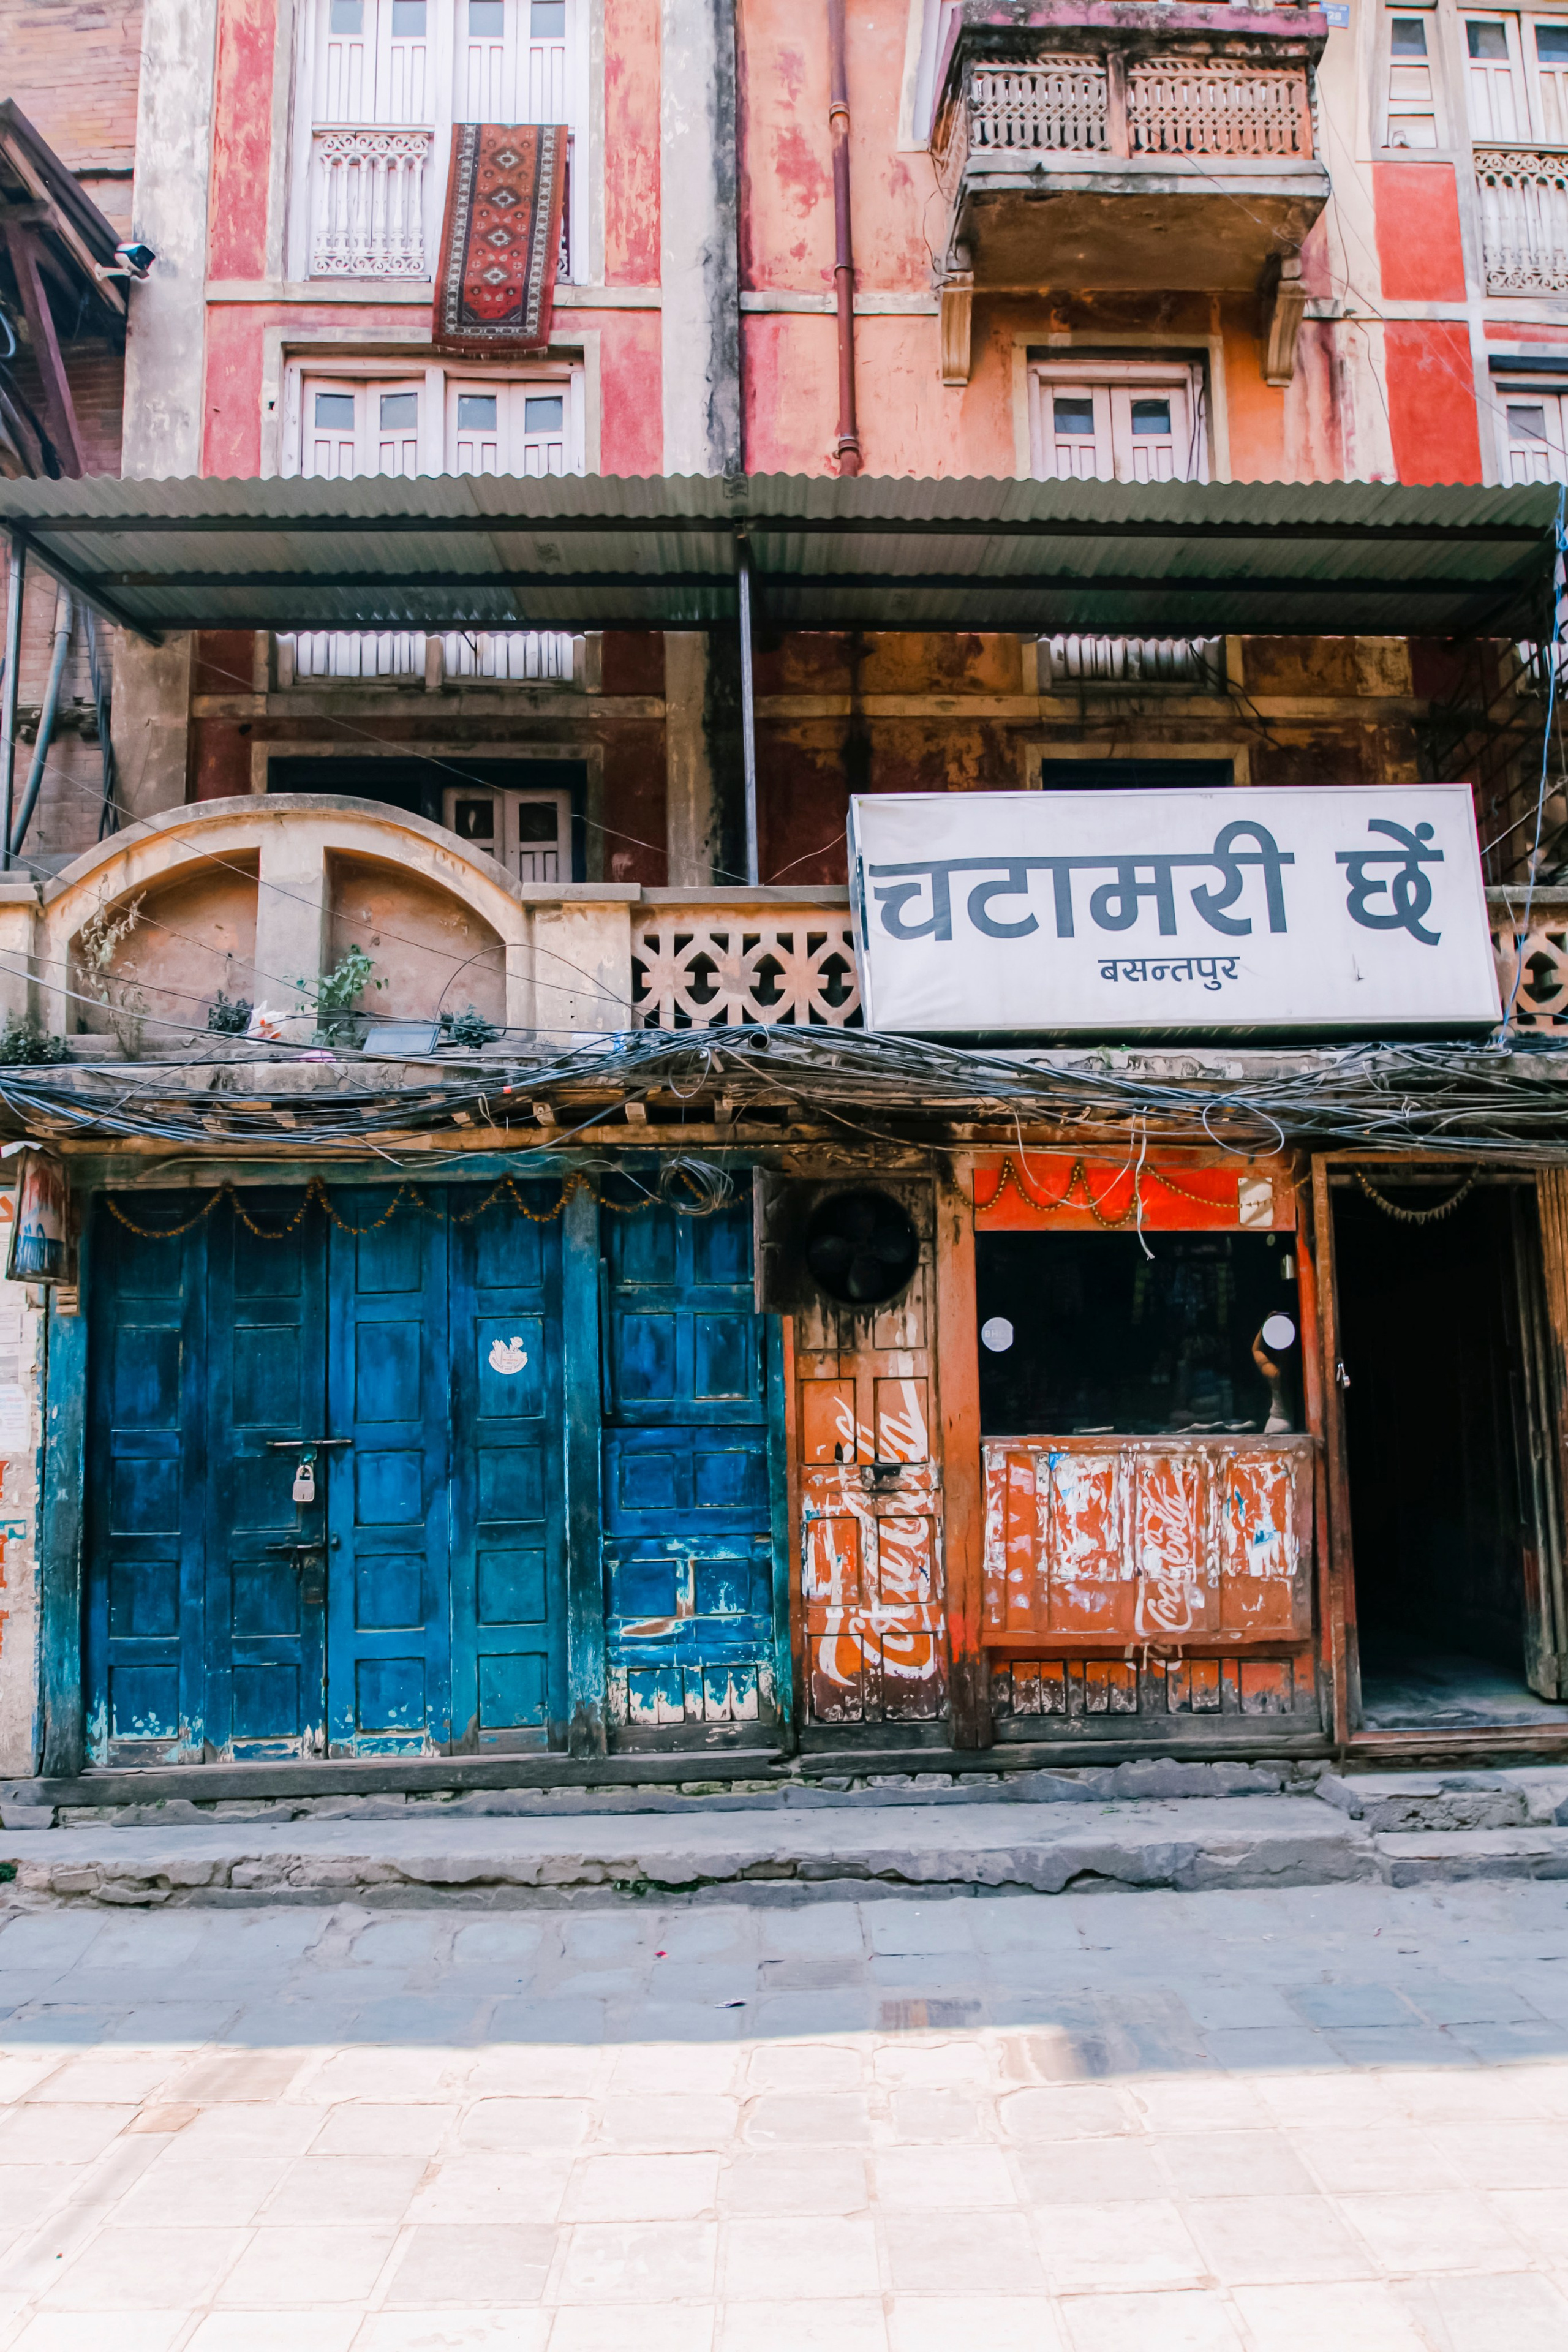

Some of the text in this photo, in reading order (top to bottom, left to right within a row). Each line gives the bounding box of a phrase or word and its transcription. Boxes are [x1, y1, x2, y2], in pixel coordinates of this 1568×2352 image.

[869, 819, 1444, 946] चटामरी छें
[1098, 957, 1240, 990] बसन्तपुर
[1135, 1470, 1193, 1637] CocaCola
